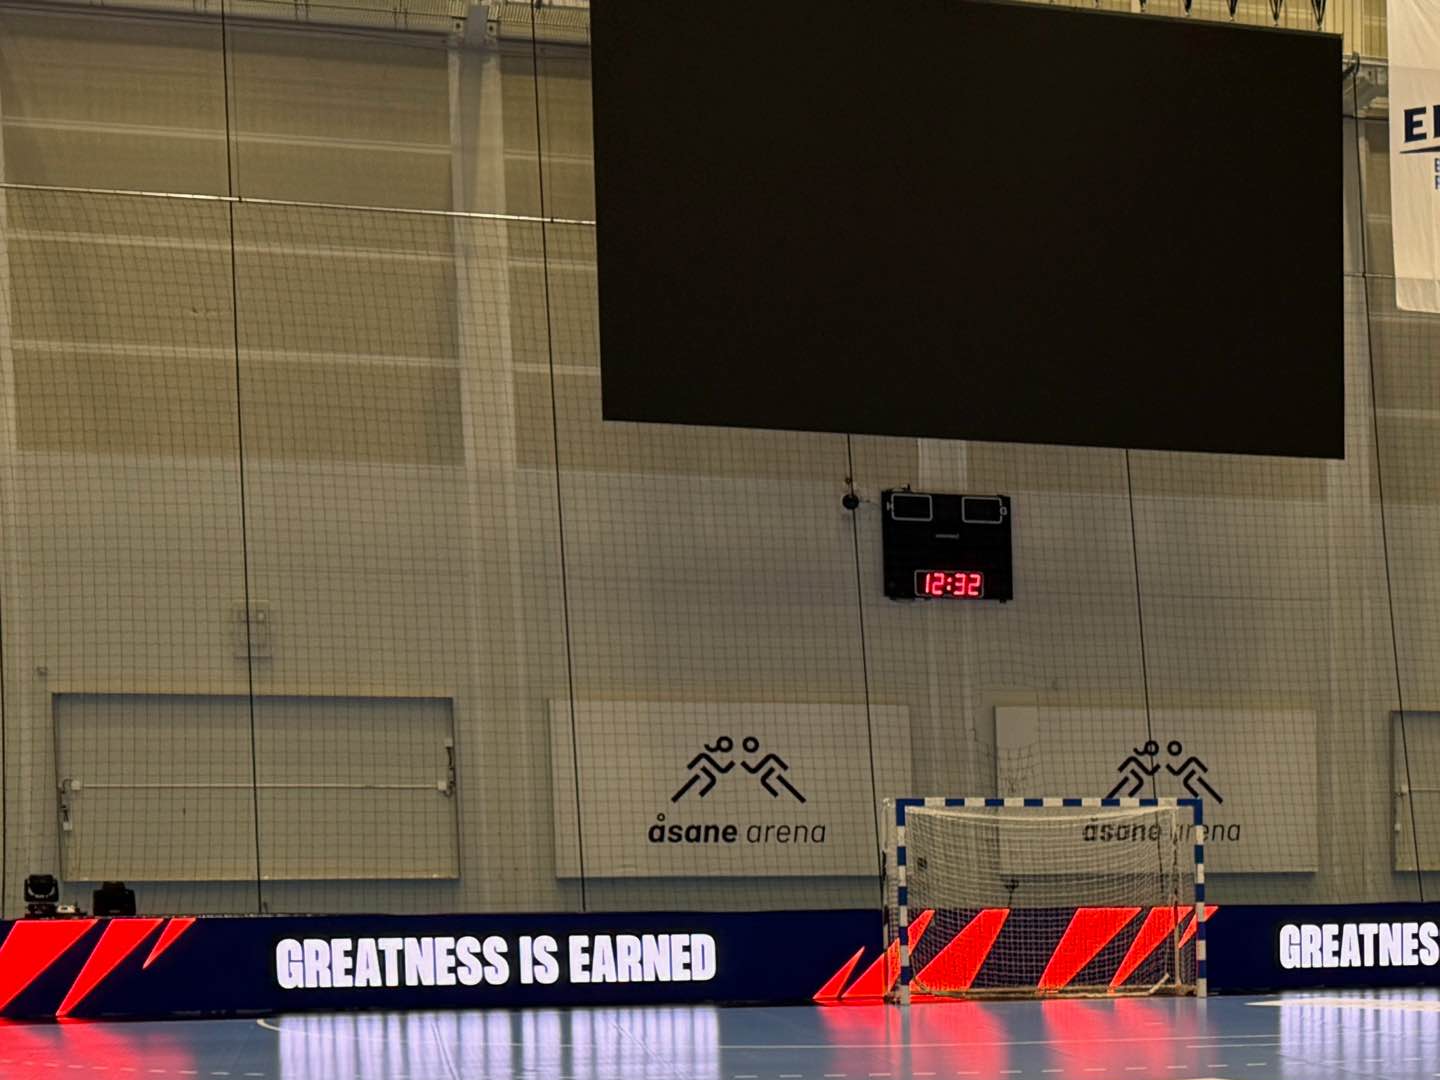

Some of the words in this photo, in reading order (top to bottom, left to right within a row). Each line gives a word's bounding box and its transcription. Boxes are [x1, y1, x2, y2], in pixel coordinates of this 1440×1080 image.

[925, 572, 981, 596] 12:32
[648, 812, 738, 843] åsane
[746, 824, 826, 843] arena
[276, 935, 510, 989] GREATNESS
[519, 936, 560, 985] IS
[568, 933, 717, 984] EARNED
